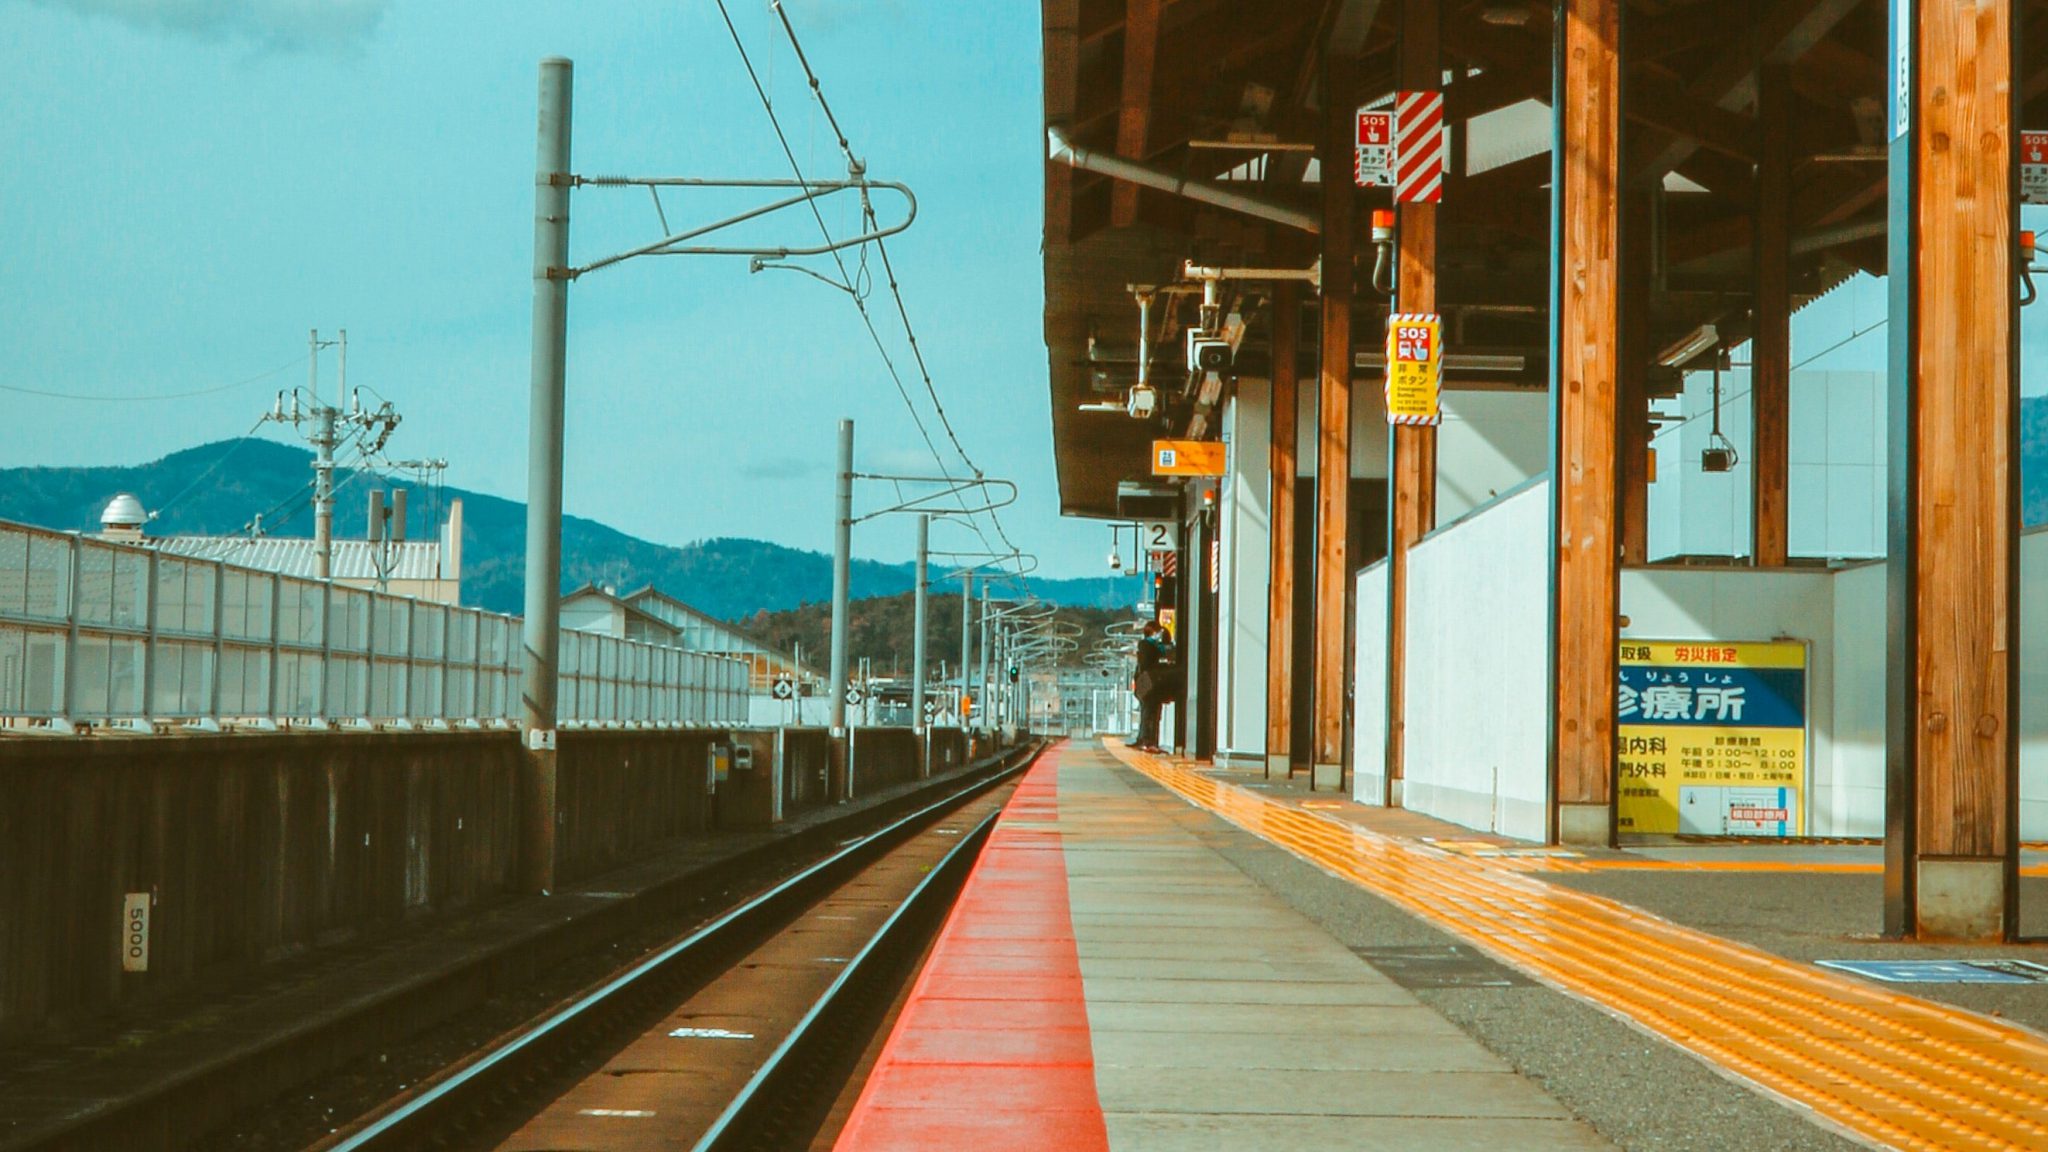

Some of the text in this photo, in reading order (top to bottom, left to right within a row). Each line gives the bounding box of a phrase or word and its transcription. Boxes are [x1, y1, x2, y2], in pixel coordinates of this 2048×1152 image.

[1362, 116, 1386, 126] SOS
[2025, 135, 2048, 145] SOS
[1362, 156, 1385, 164] ボタン
[1398, 328, 1428, 340] SOS
[1397, 376, 1428, 385] ボタン
[1152, 524, 1166, 545] 2
[1621, 646, 1737, 663] 取扱 労災指定
[780, 684, 787, 694] 4
[542, 732, 549, 743] 2
[130, 908, 143, 958] 5000
